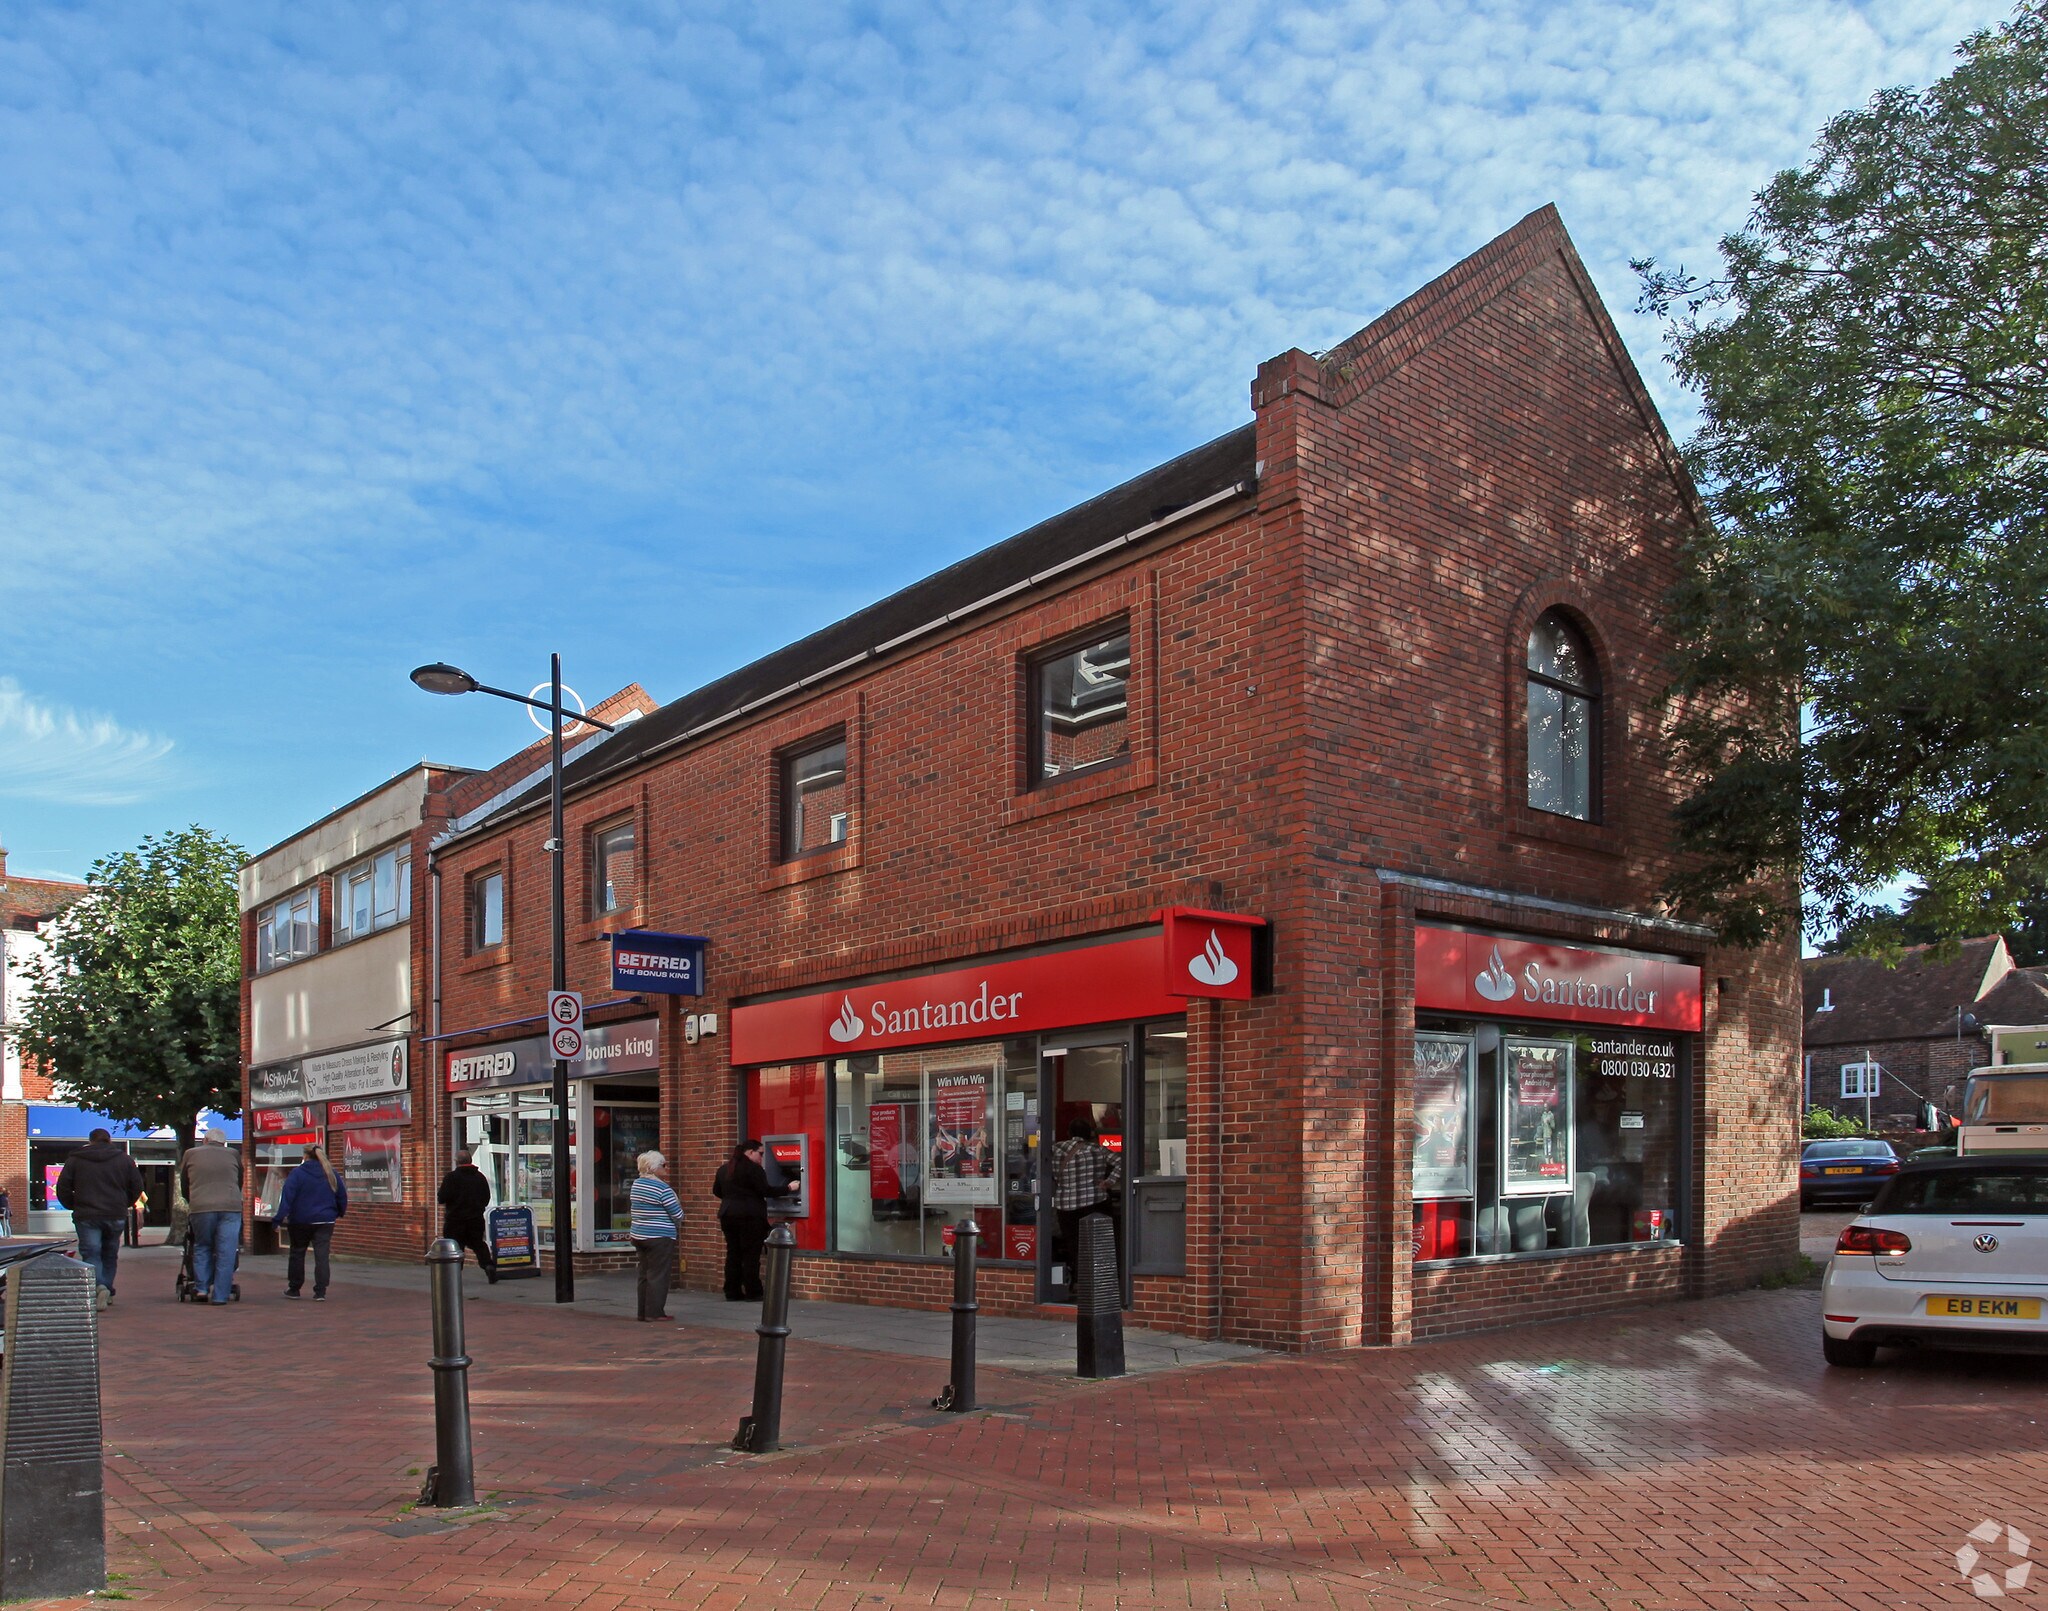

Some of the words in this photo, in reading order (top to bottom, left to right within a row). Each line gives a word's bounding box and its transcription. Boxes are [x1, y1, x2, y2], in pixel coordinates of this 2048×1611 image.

[618, 952, 691, 971] BETFRED
[637, 969, 668, 978] BONUS
[669, 972, 690, 980] KING
[1523, 962, 1659, 1014] Santander
[870, 980, 1023, 1037] Santander
[585, 1042, 622, 1061] bonus
[625, 1037, 654, 1058] king
[1591, 1039, 1675, 1058] santander.co.uk
[341, 1057, 352, 1067] Dress
[370, 1050, 389, 1062] Restyling
[450, 1051, 517, 1083] BETFRED
[1601, 1060, 1628, 1076] 0800
[1630, 1061, 1650, 1078] 030
[1652, 1062, 1676, 1078] 4321
[937, 1077, 952, 1087] Win
[953, 1075, 969, 1086] Win
[970, 1074, 985, 1085] Win
[331, 1104, 351, 1114] 07522
[352, 1100, 378, 1112] 012545
[880, 1109, 896, 1117] products
[1109, 1138, 1122, 1147] Sant
[595, 1232, 610, 1242] sky
[612, 1233, 632, 1241] SPO
[1947, 1299, 1972, 1314] E8
[1978, 1300, 2018, 1316] EKM
